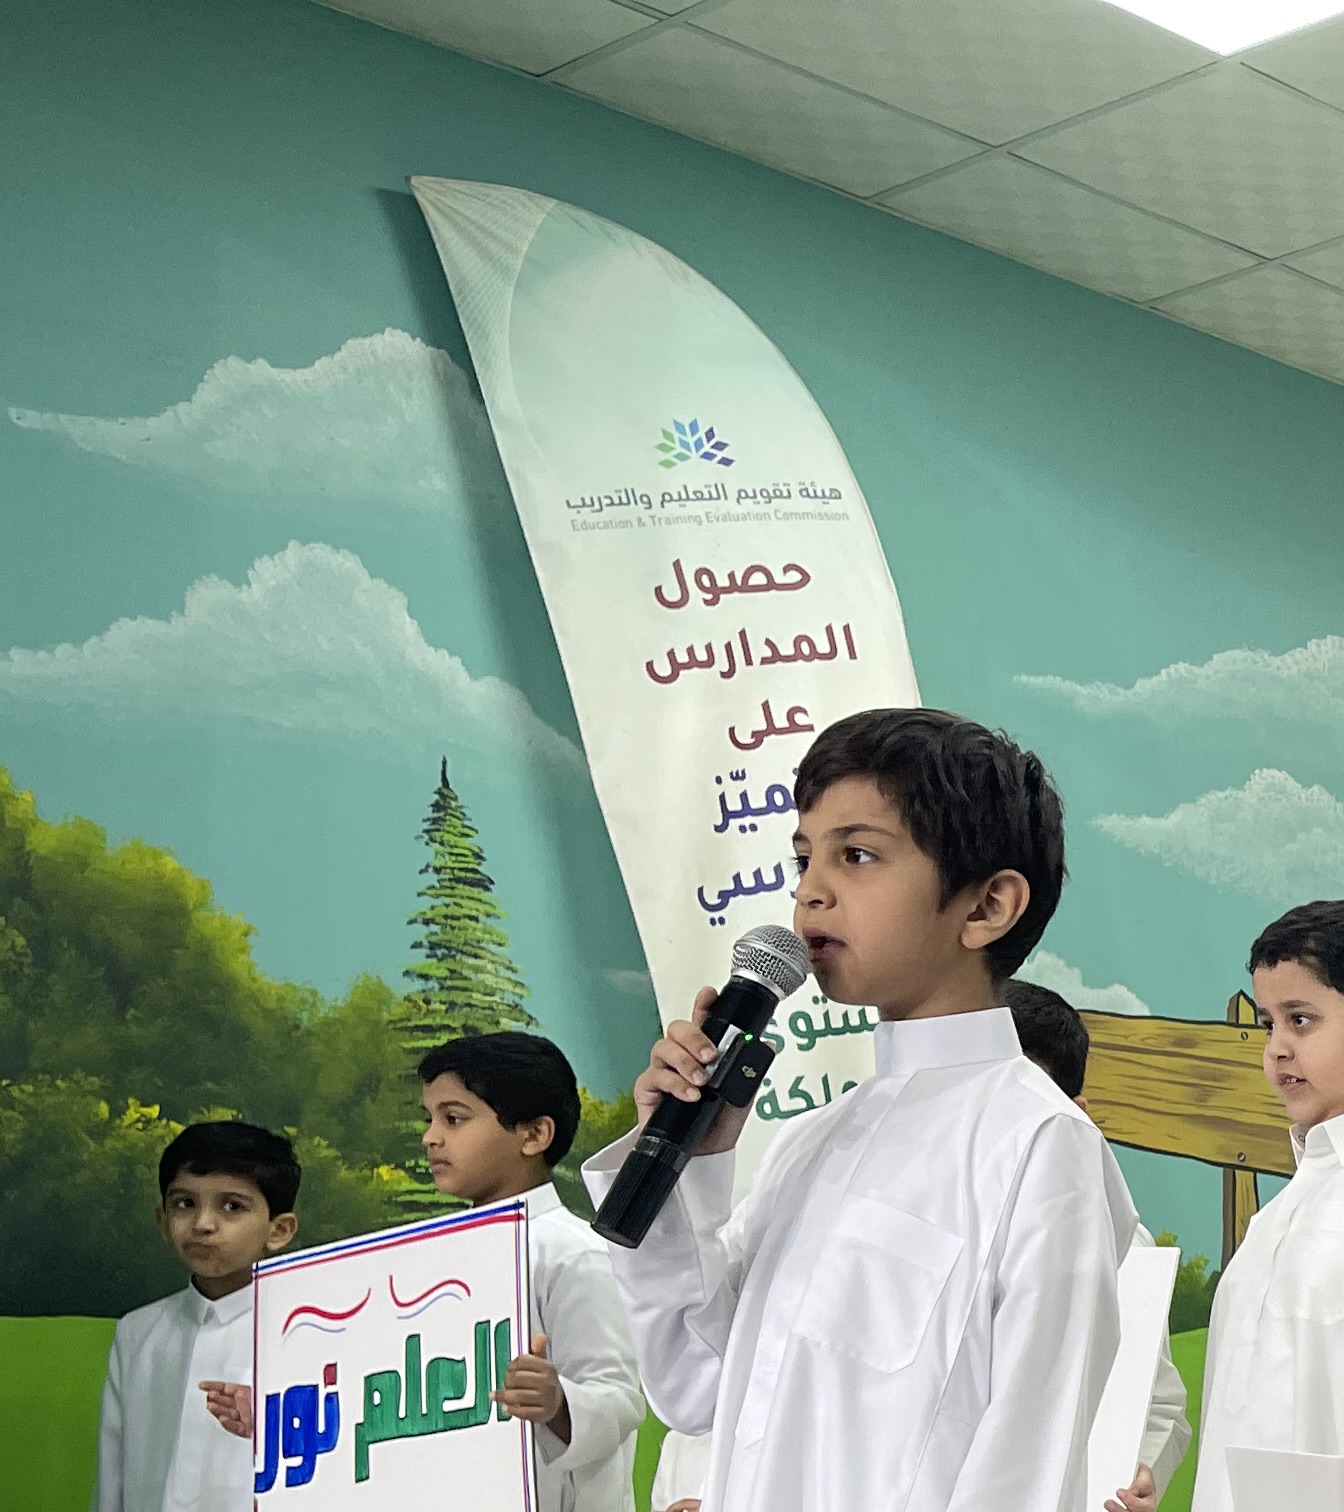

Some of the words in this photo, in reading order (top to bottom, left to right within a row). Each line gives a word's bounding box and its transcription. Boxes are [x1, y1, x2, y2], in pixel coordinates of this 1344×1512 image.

[565, 487, 653, 514] والتدريب
[660, 483, 728, 509] التعليم
[736, 482, 792, 505] تقويم
[798, 481, 842, 504] هيئة
[570, 519, 633, 532] Education
[637, 516, 646, 528] &
[649, 512, 703, 527] Training
[705, 510, 772, 523] Evaluation
[774, 508, 850, 521] Commission
[654, 558, 811, 609] حصول
[645, 622, 857, 684] المدارس
[728, 699, 815, 750] على
[355, 1317, 512, 1484] العلم
[254, 1362, 340, 1494] نور
